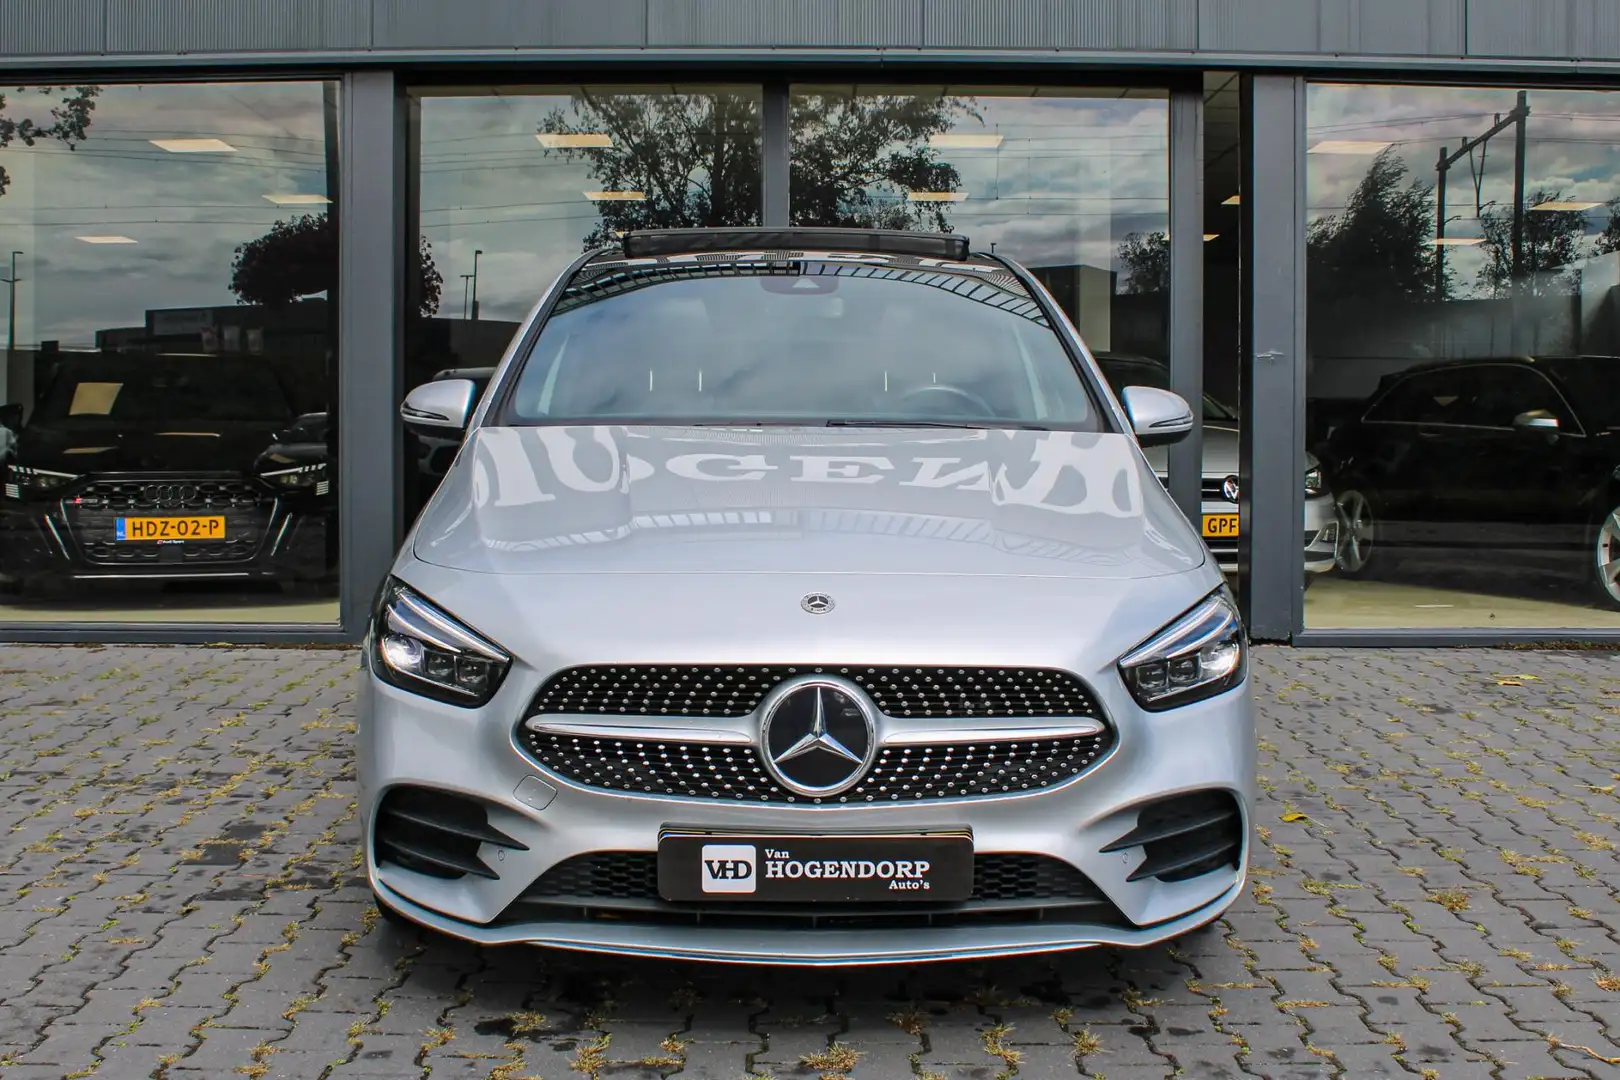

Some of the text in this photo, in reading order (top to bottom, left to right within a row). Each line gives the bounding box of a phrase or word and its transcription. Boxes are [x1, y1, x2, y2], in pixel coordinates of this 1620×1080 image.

[132, 519, 220, 537] HDZ-02-P
[1207, 517, 1239, 533] GPF
[765, 848, 790, 859] Van
[764, 860, 931, 879] HOGENDORP
[888, 879, 931, 890] Auto's
